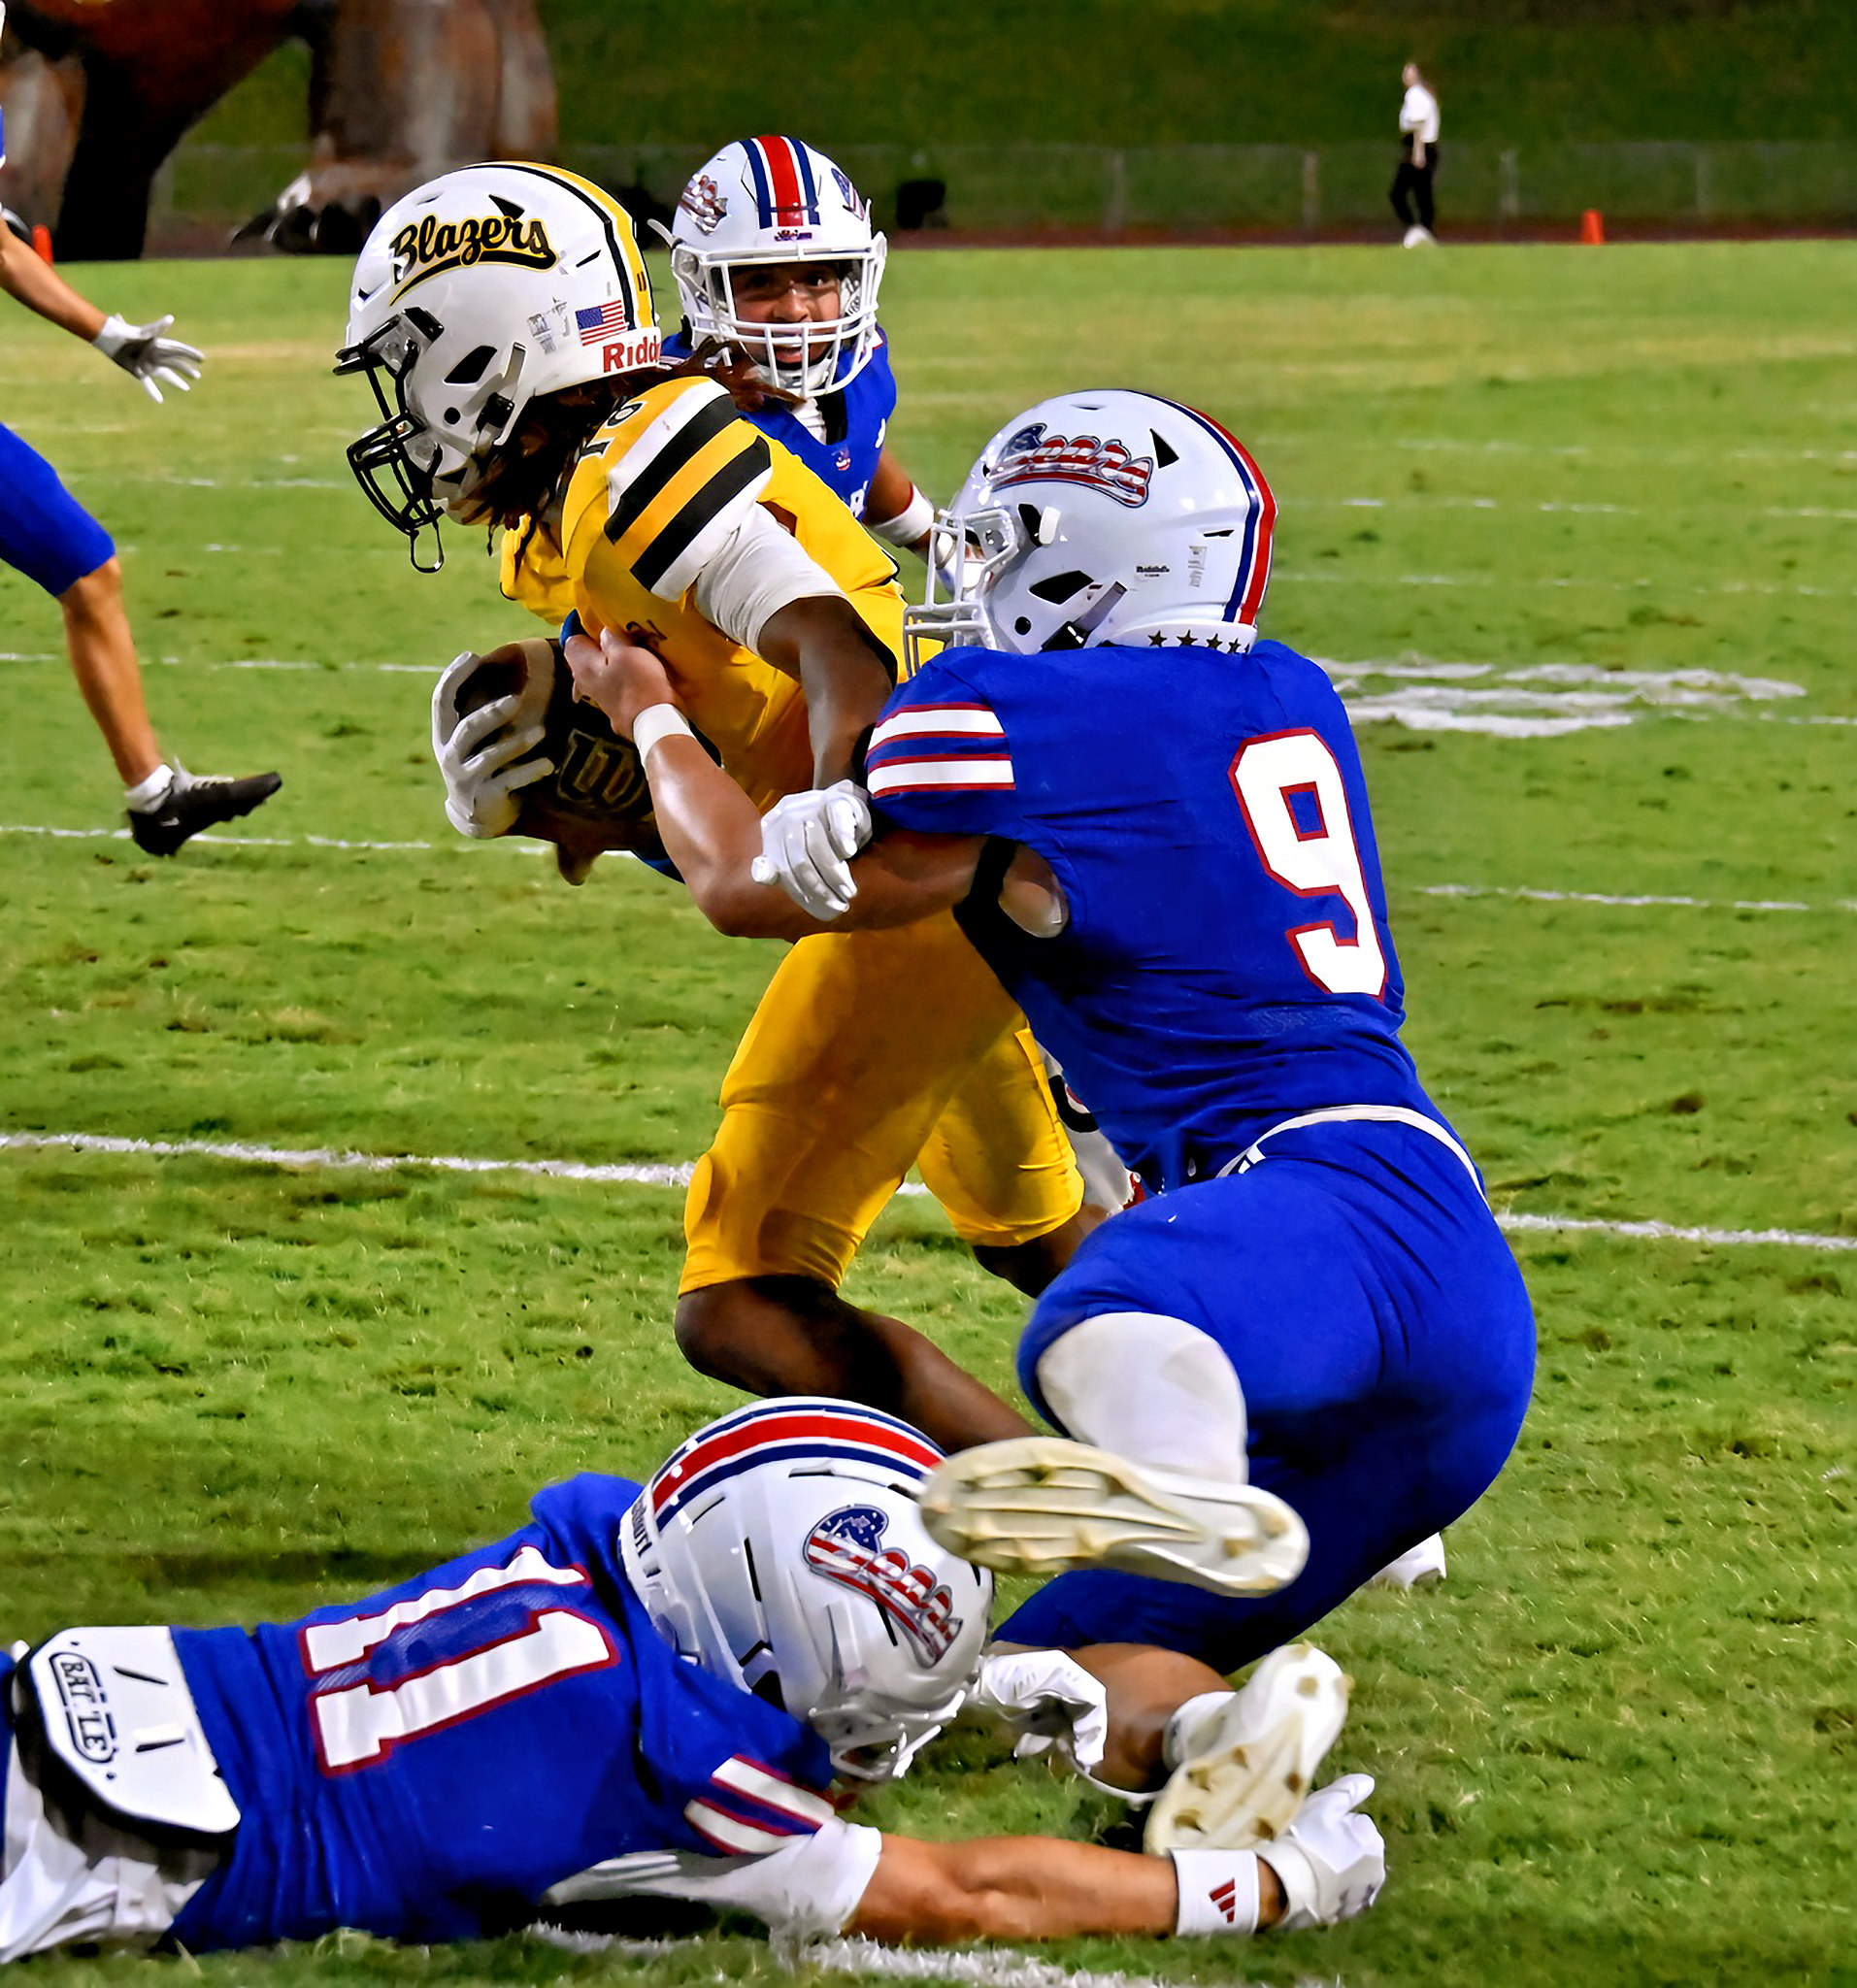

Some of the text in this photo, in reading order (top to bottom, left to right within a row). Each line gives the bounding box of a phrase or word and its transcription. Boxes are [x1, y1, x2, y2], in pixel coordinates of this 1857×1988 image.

[388, 202, 558, 293] Blazers
[603, 335, 660, 374] Ridd
[1228, 726, 1388, 1005] 9
[299, 1542, 619, 1777] 11
[59, 1662, 108, 1751] BATLE
